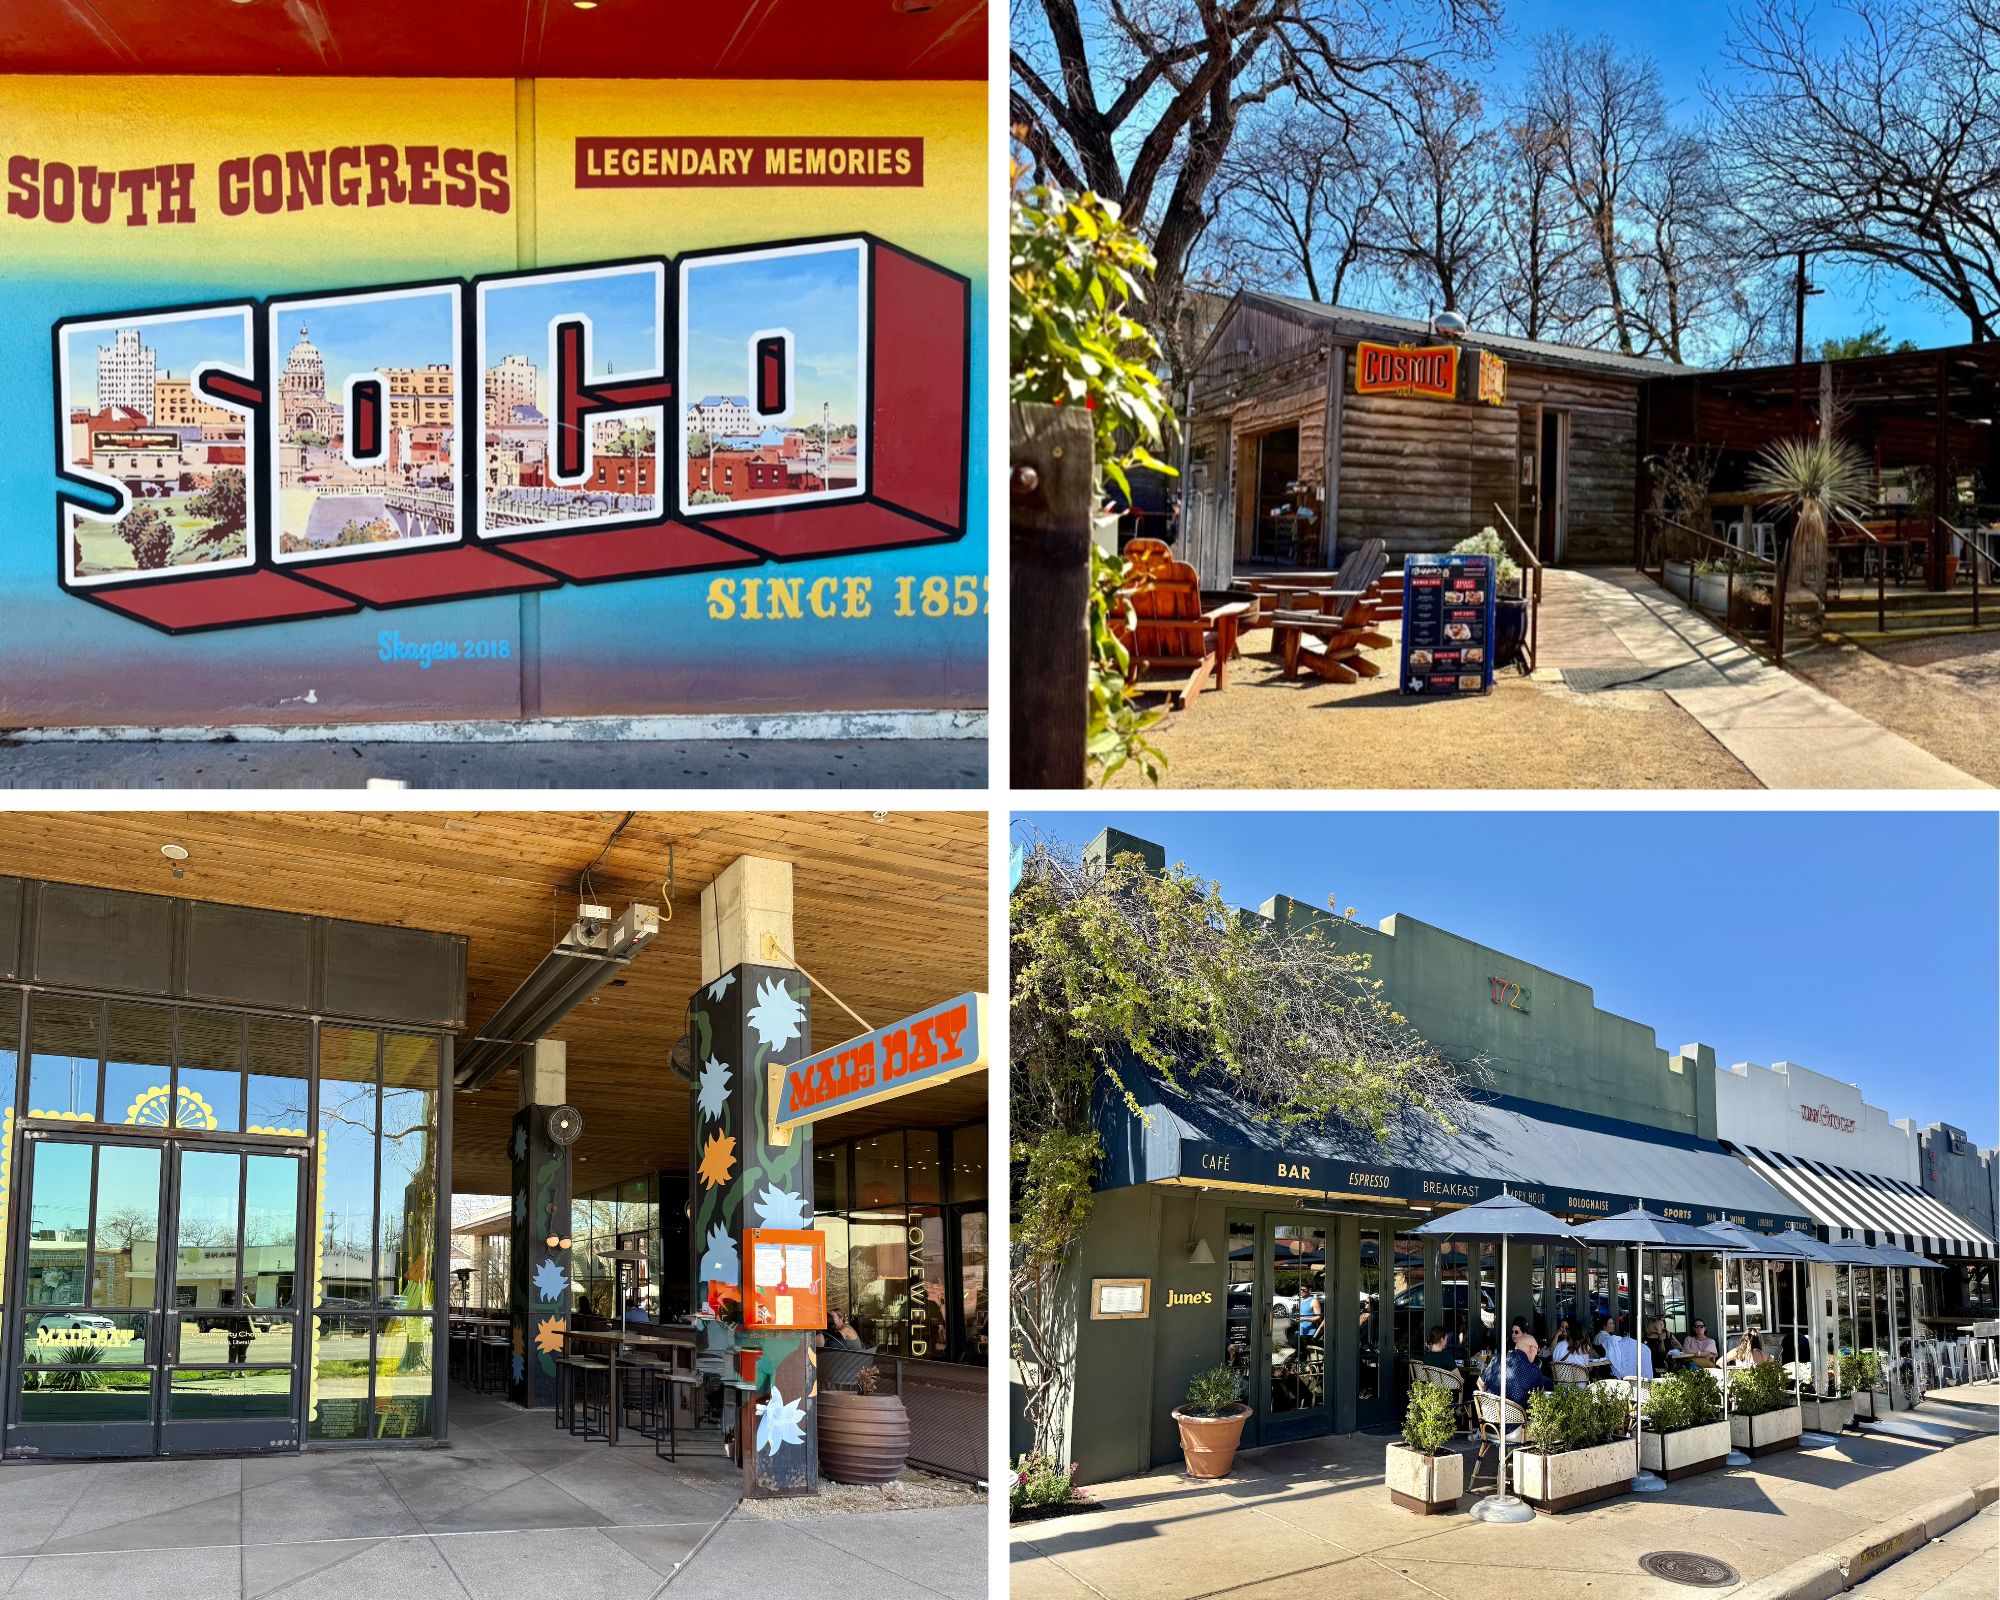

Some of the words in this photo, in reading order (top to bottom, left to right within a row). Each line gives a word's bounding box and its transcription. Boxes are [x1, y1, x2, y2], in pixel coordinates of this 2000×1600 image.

[7, 155, 197, 226] SOUTH
[218, 144, 511, 214] CONGRESS
[587, 148, 754, 176] LEGENDARY
[765, 148, 912, 176] MEMORIES
[1365, 351, 1449, 389] COSMIC
[54, 232, 971, 634] SOCO
[706, 576, 872, 619] SINCE
[894, 576, 988, 618] 185
[378, 630, 460, 669] Skagen
[463, 639, 511, 659] 2018
[882, 1004, 968, 1083] DAY
[1202, 1153, 1231, 1172] CAFÉ
[1277, 1163, 1311, 1181] BAR
[1348, 1172, 1390, 1188] ESPRESSO
[1423, 1180, 1480, 1198] BREAKFAST
[1528, 1192, 1546, 1204] HOUR
[1568, 1196, 1609, 1211] BOLOGNAISE
[1663, 1208, 1692, 1219] SPORTS
[1729, 1214, 1746, 1225] WINE
[908, 1213, 927, 1356] LOVEWELD
[1166, 1289, 1213, 1308] June's
